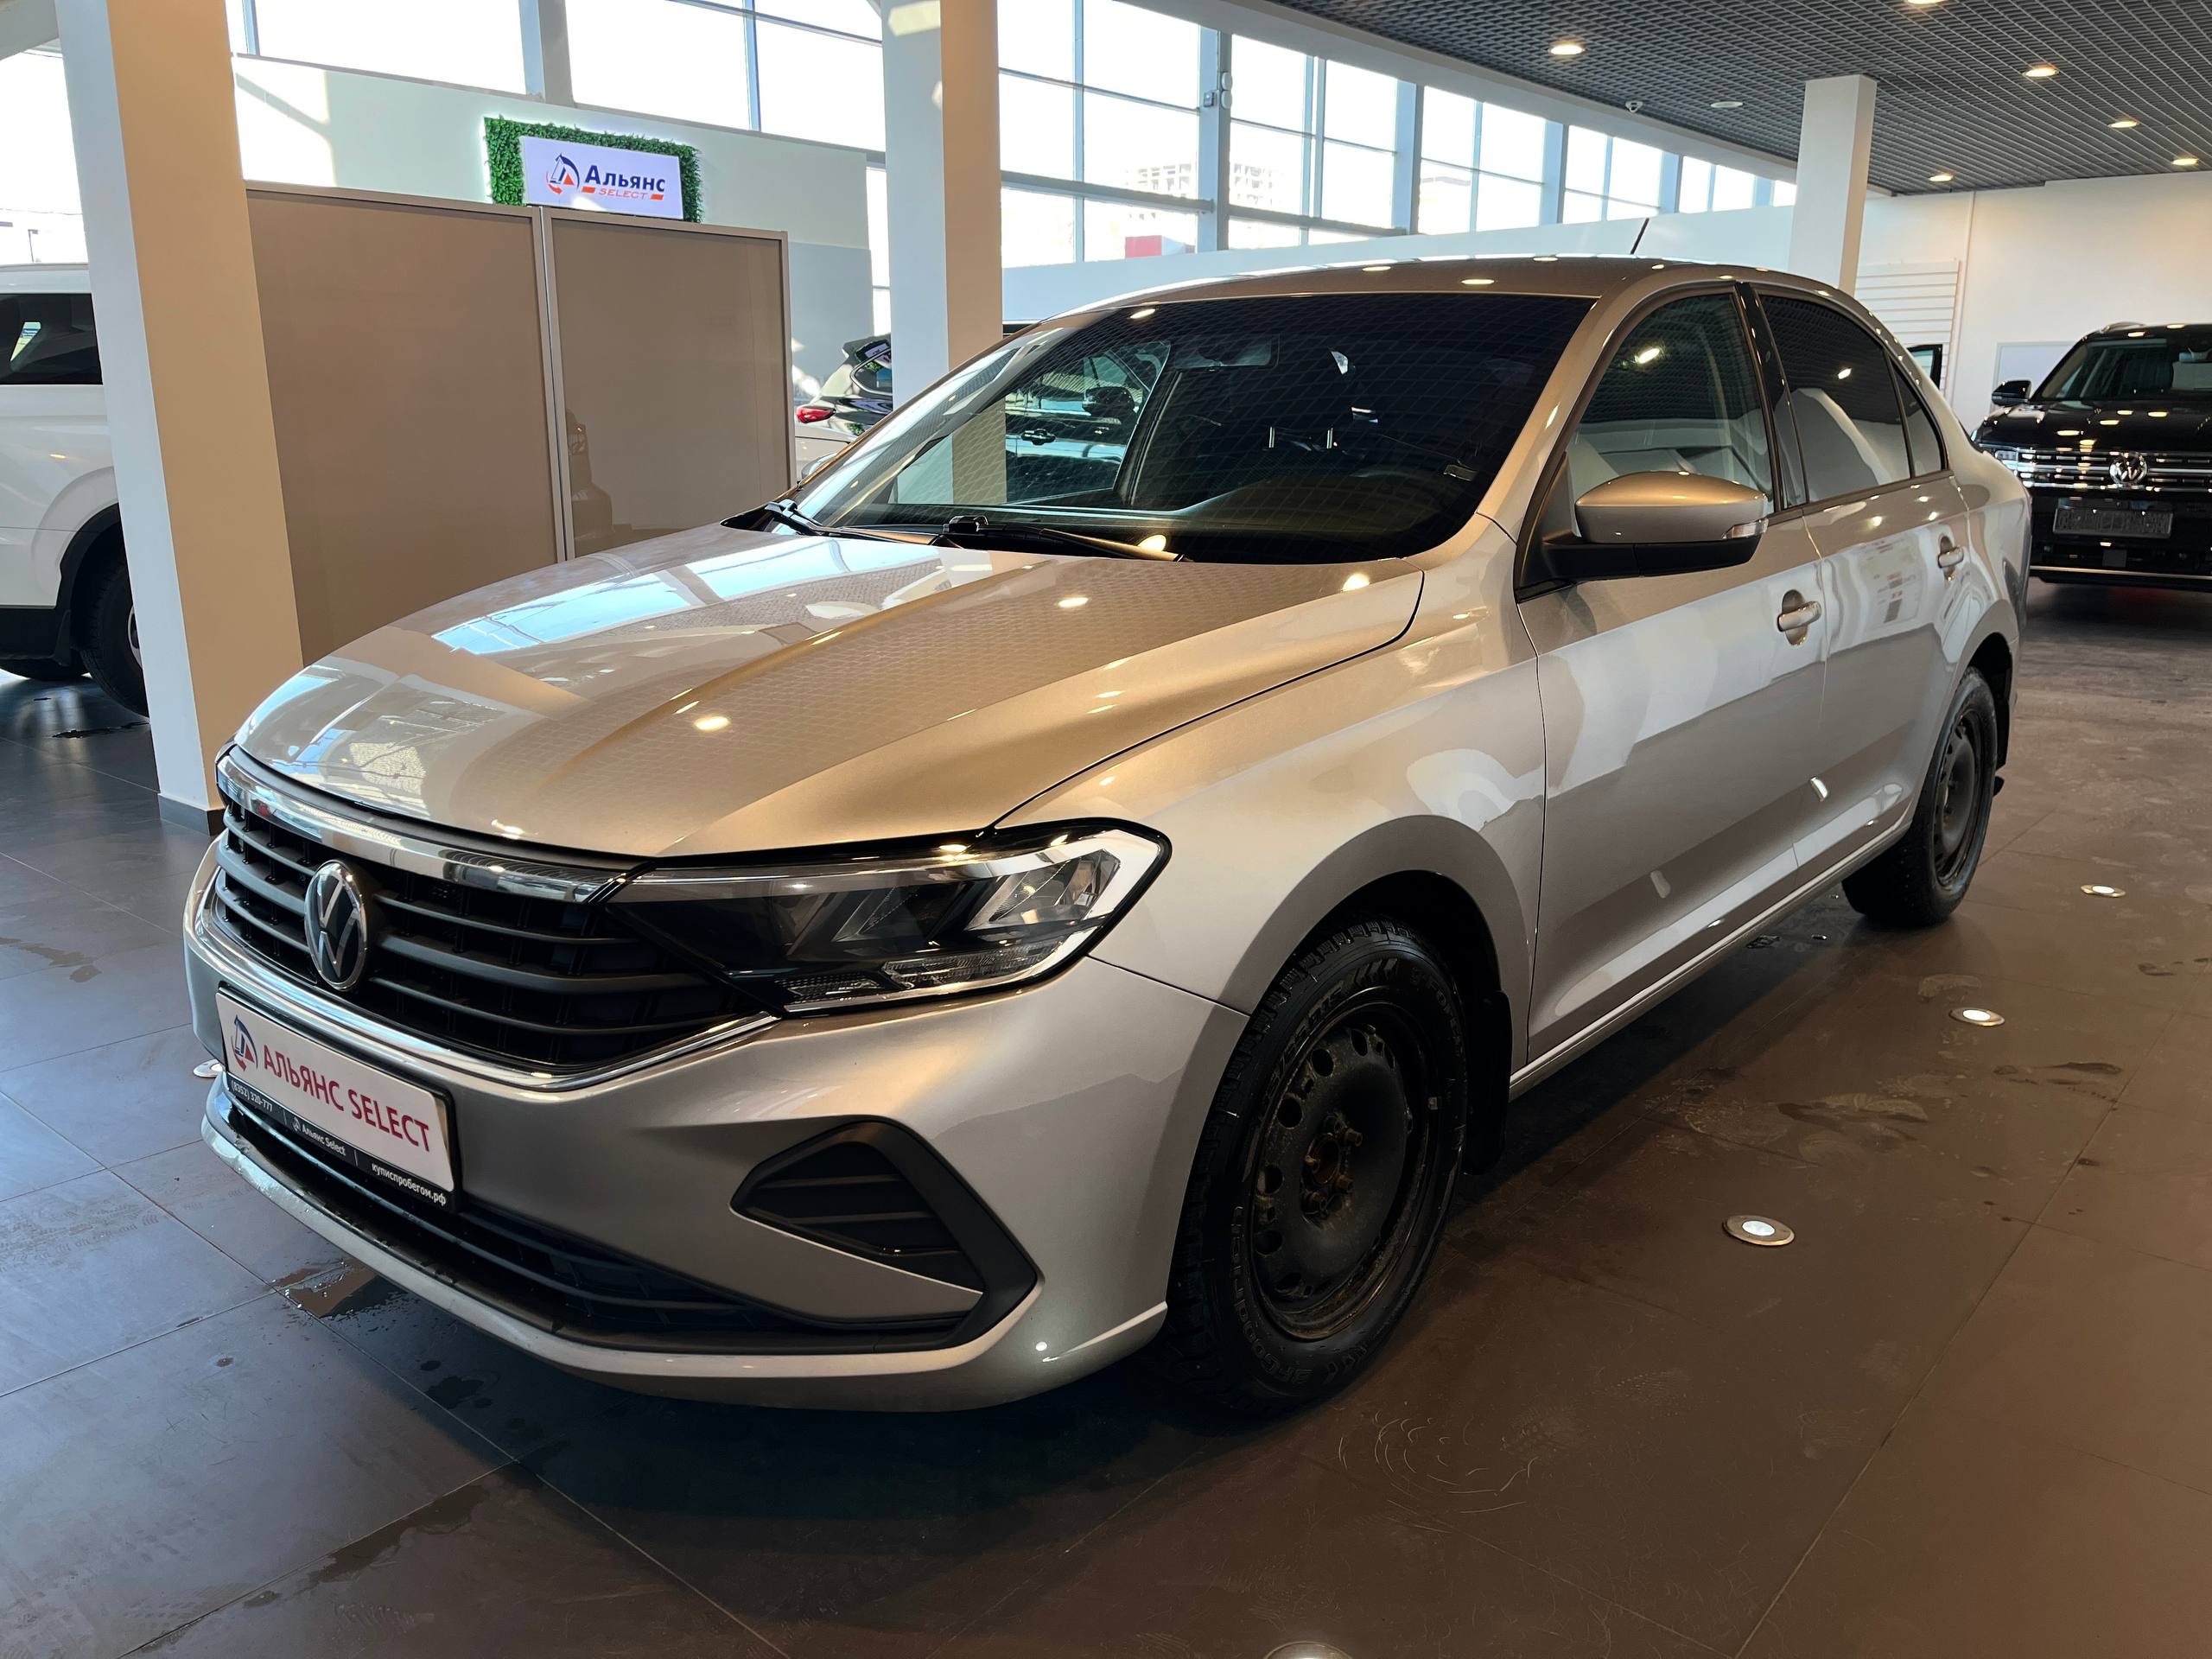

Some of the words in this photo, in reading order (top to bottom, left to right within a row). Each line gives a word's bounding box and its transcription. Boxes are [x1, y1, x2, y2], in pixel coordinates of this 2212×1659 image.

[584, 164, 666, 193] Альянс
[598, 188, 648, 200] SELECT
[263, 1044, 344, 1112] АЛЬЯНС
[347, 1088, 430, 1152] SELECT
[302, 1124, 325, 1145] Альянс
[325, 1137, 346, 1156] Select
[371, 1163, 447, 1206] куписпробегом.рф
